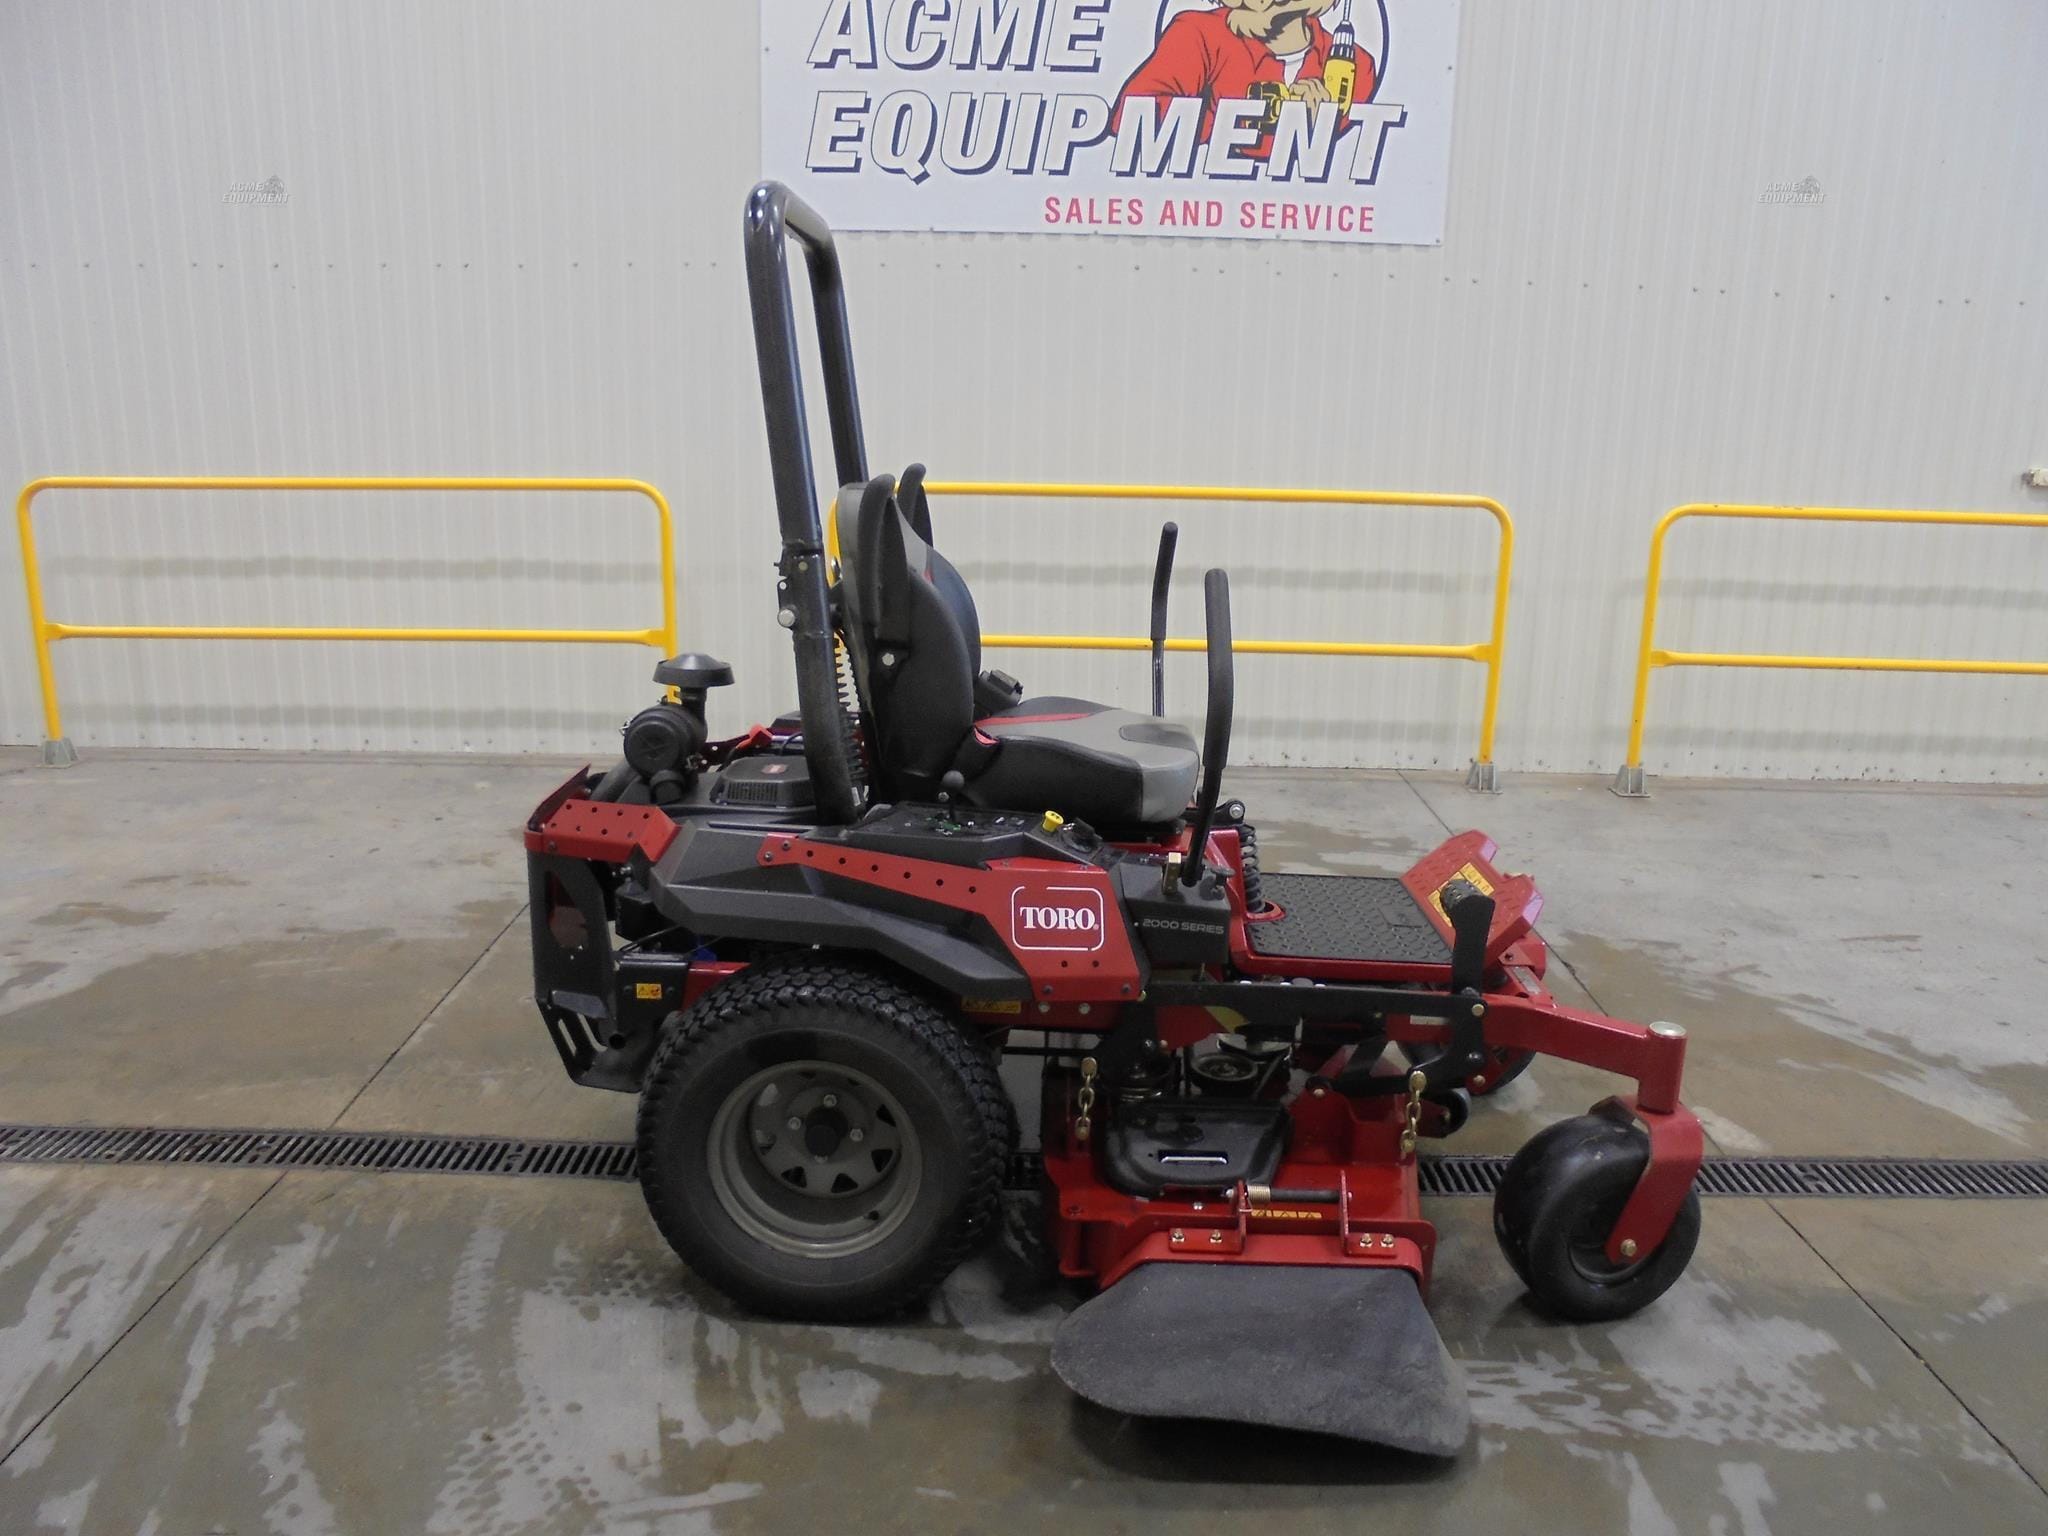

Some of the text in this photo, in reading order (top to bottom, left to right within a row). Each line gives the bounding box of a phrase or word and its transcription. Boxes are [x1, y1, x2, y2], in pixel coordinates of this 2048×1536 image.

[807, 0, 1111, 72] ACME
[806, 90, 1408, 185] EQUIPMENT
[1045, 197, 1375, 233] SALES AND SERVICE
[1019, 906, 1096, 930] TORO
[1142, 918, 1225, 935] 2000 SERIES
